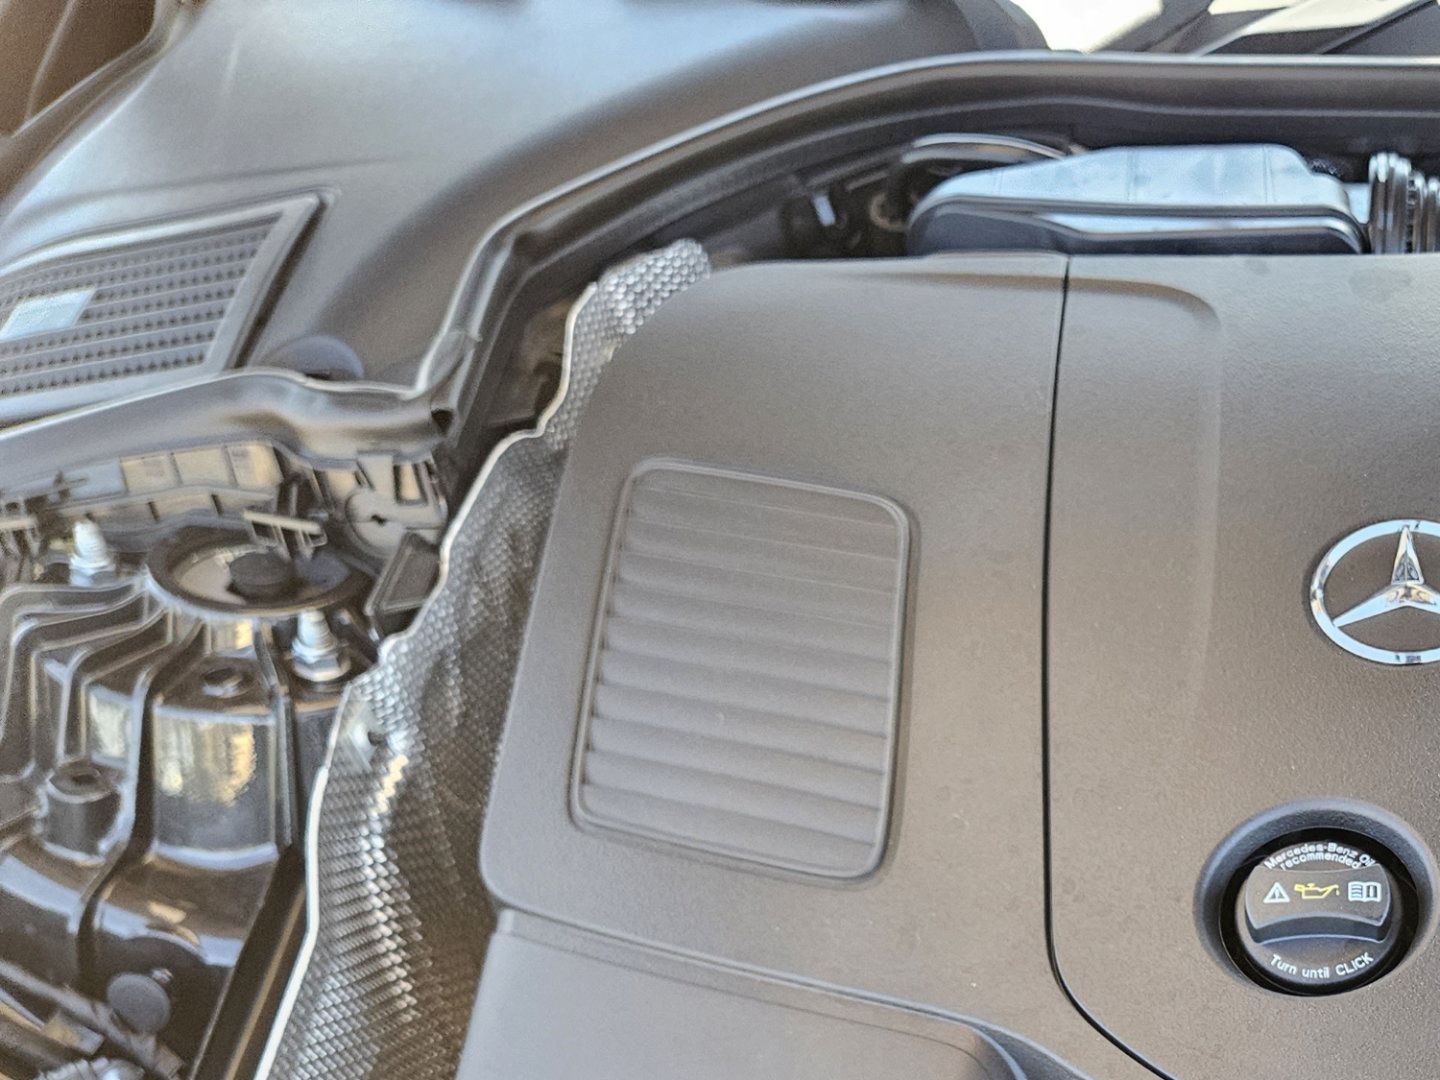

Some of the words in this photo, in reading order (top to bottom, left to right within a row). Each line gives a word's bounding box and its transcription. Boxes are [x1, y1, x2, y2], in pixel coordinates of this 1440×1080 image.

[1264, 842, 1356, 870] Mercedes-Benz
[1359, 853, 1377, 867] Oil
[1280, 851, 1362, 871] recommended
[1270, 953, 1297, 976] Turn
[1302, 966, 1330, 978] until
[1335, 952, 1374, 976] CLICK
